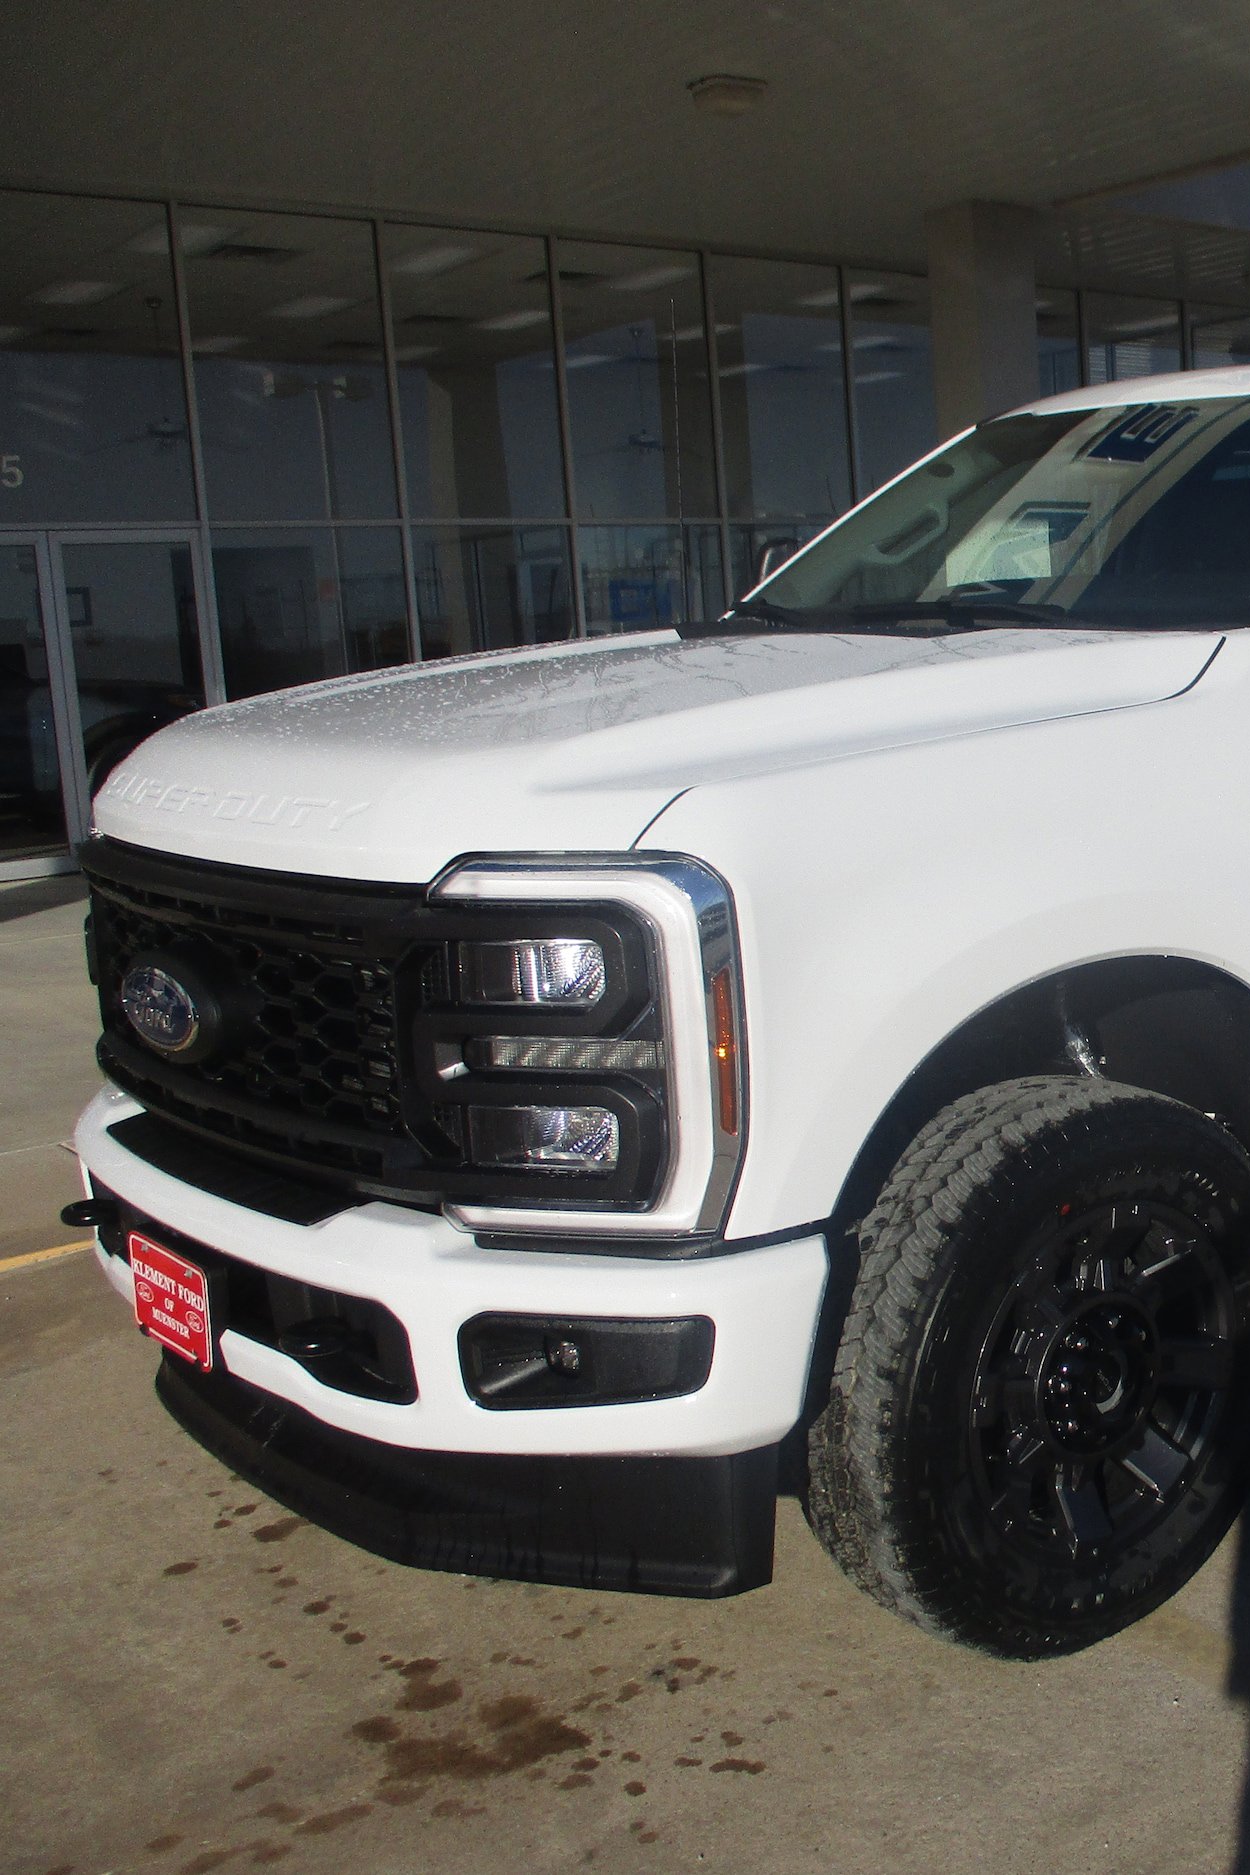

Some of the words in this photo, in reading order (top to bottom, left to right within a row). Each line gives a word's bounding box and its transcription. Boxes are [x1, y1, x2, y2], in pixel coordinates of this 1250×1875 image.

[212, 791, 374, 832] DUTY
[132, 1257, 176, 1295] KLEMENT
[177, 1283, 205, 1312] FORD
[151, 1306, 190, 1339] MUENSTER
[164, 1297, 175, 1312] OF
